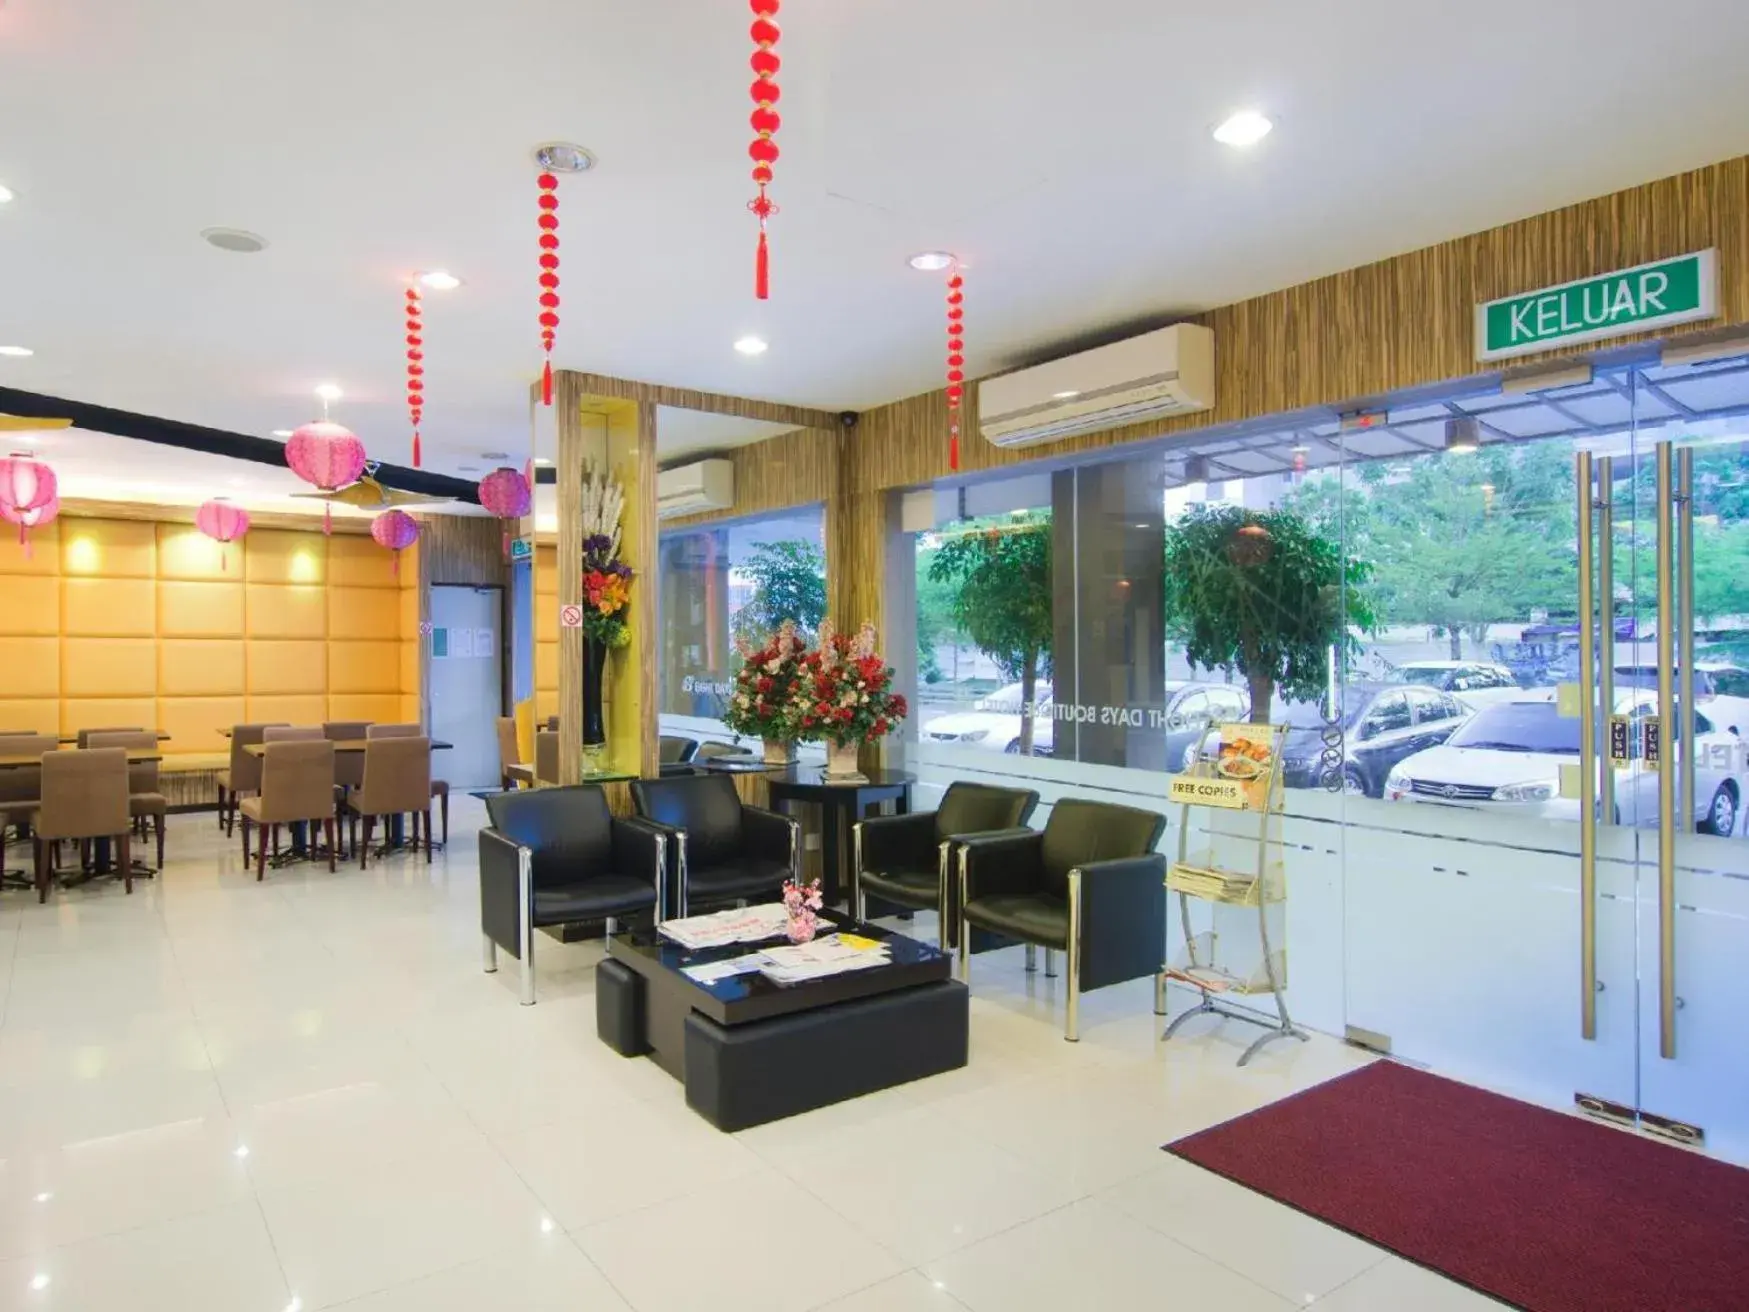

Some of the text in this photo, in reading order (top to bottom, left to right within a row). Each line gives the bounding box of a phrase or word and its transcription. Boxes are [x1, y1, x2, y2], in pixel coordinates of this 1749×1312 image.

[1510, 271, 1669, 342] KELUAR
[1614, 723, 1623, 758] PUSH
[1648, 725, 1657, 760] PUSH
[1173, 783, 1237, 798] FREE COPIES
